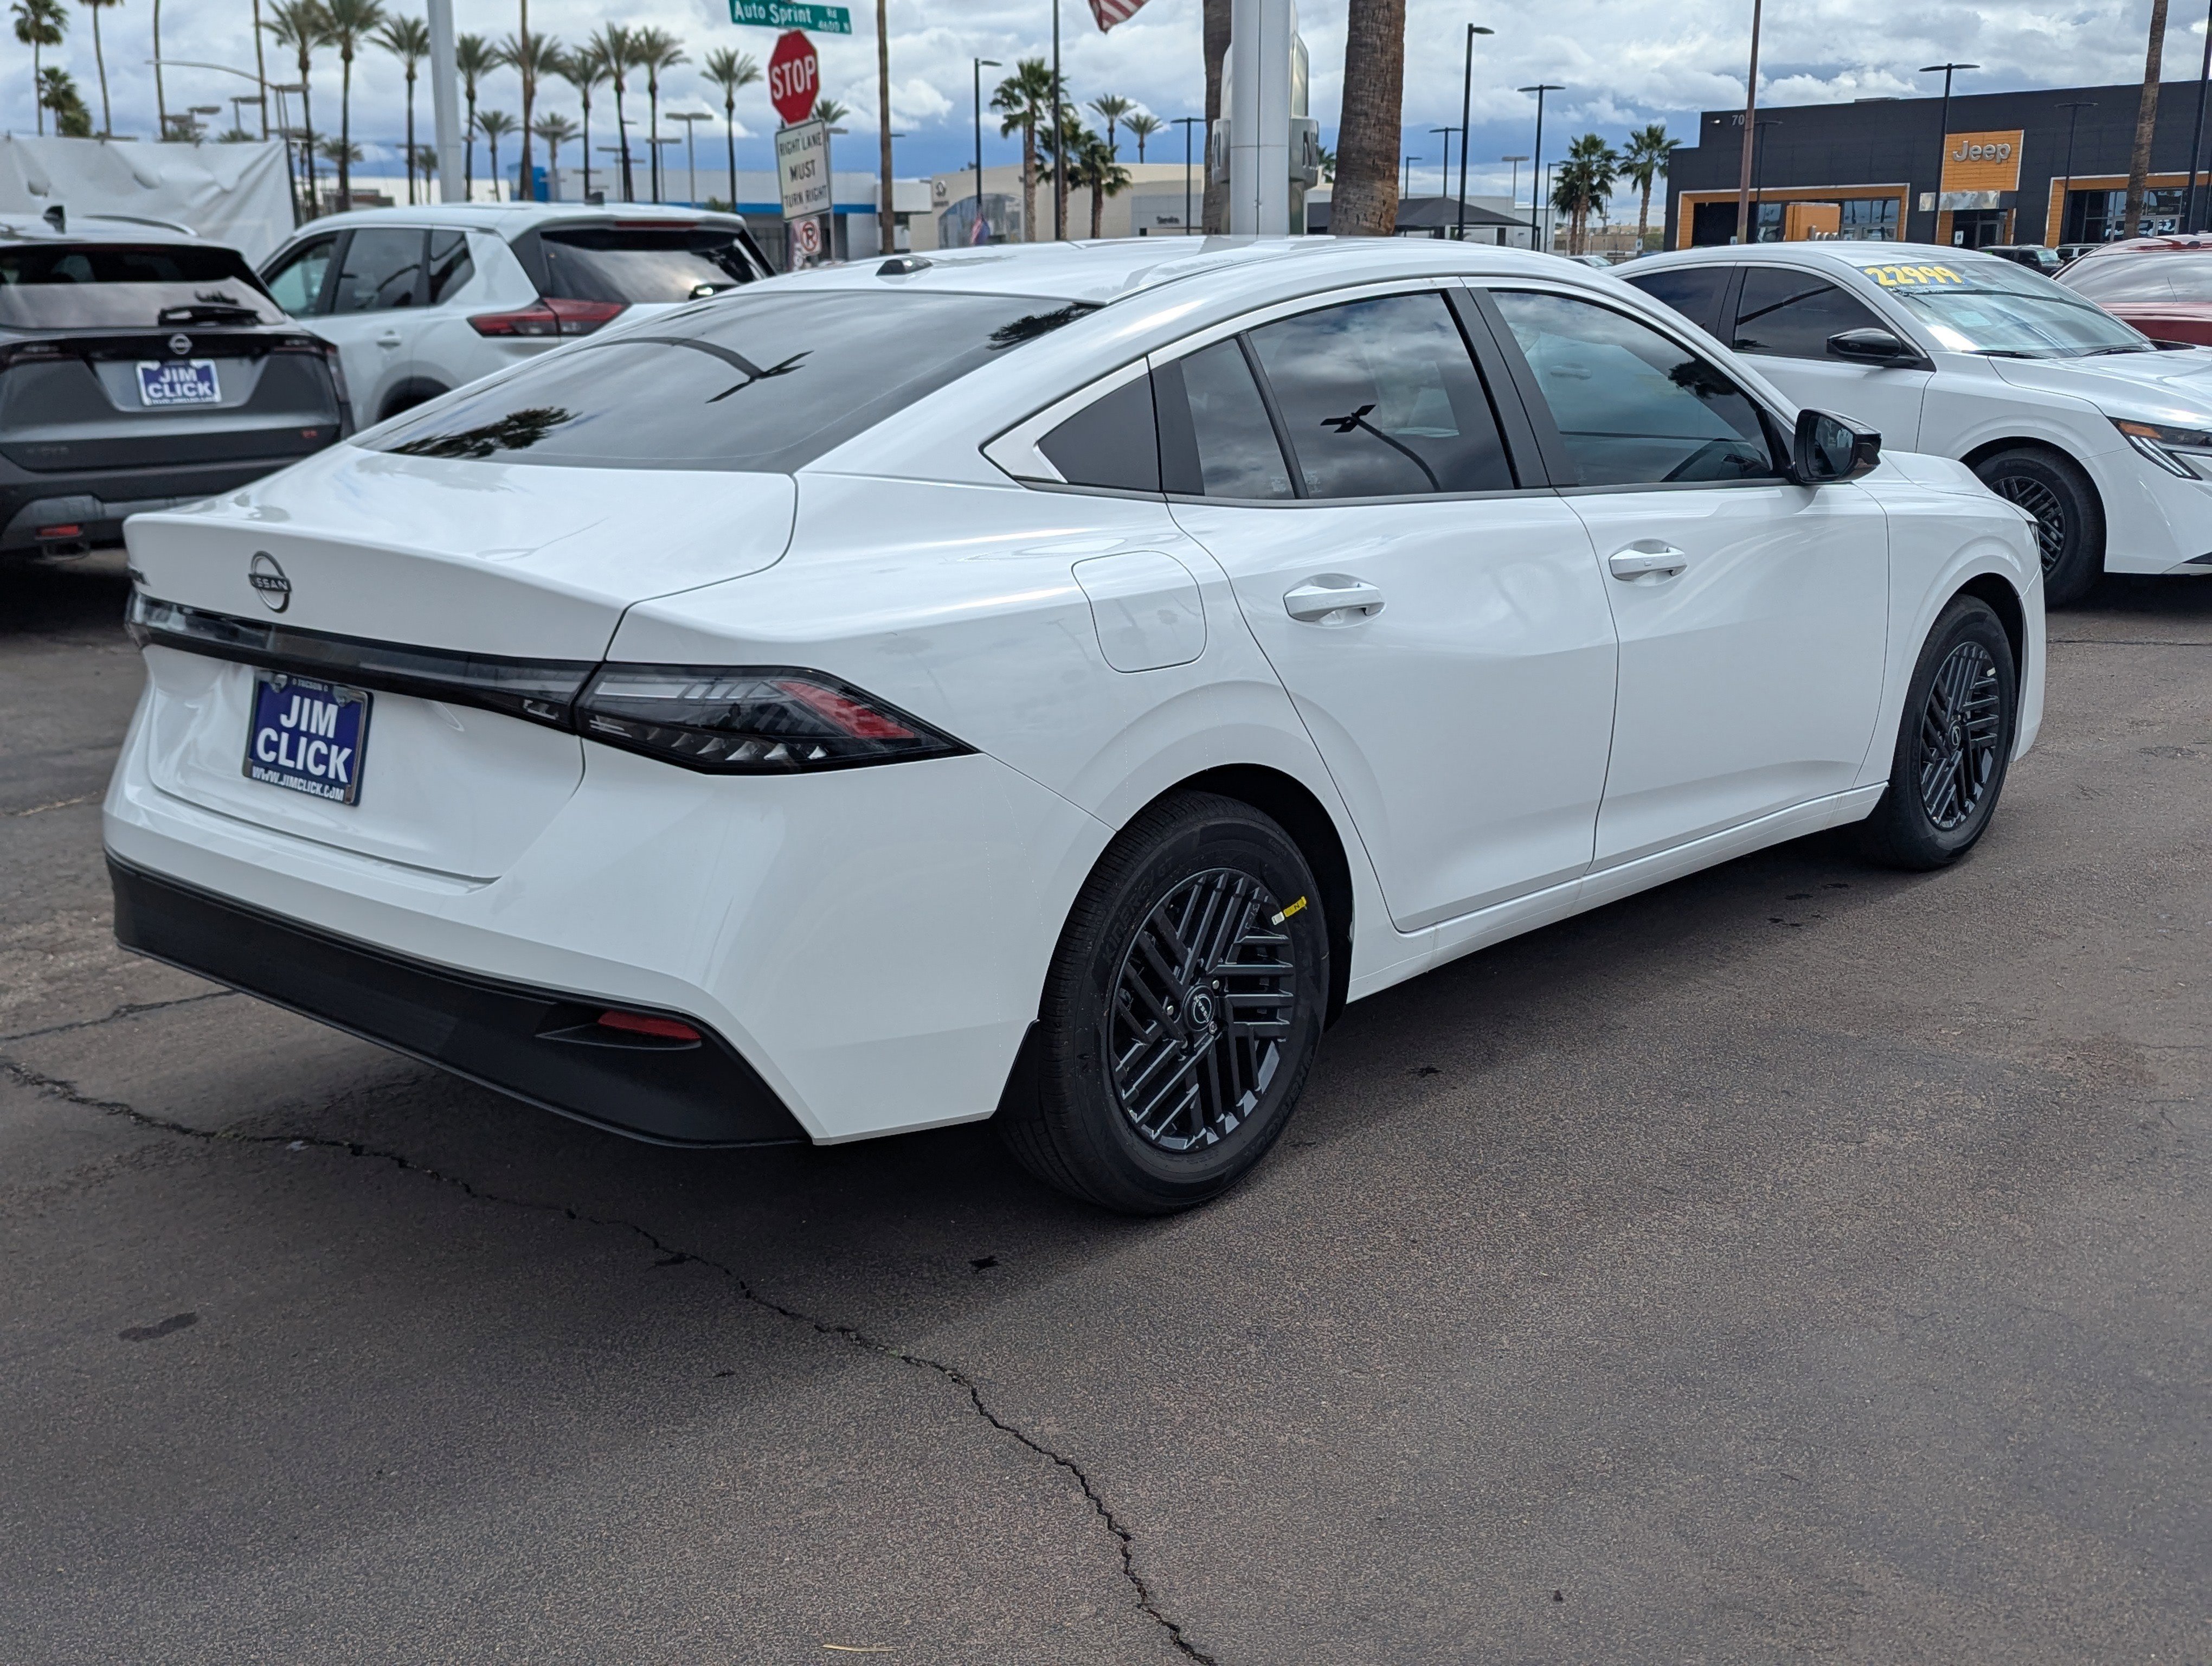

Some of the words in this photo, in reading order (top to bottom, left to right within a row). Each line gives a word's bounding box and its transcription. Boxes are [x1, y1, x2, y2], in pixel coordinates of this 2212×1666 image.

[734, 1, 766, 21] Auto
[769, 3, 812, 25] Sprint
[770, 55, 816, 100] STOP
[780, 138, 800, 157] RIGHT
[802, 132, 822, 151] LANE
[1953, 140, 2011, 164] Jeep
[789, 159, 816, 182] MUST
[784, 191, 803, 208] TURN
[805, 185, 827, 203] RIGHT
[1864, 266, 1963, 286] 22999
[158, 367, 198, 383] JIM
[147, 381, 213, 398] CLICK
[251, 576, 288, 590] SSAN
[280, 695, 339, 739] JIM
[256, 727, 352, 783] CLICK
[252, 765, 345, 802] WWW.JIMCLICK.COM
